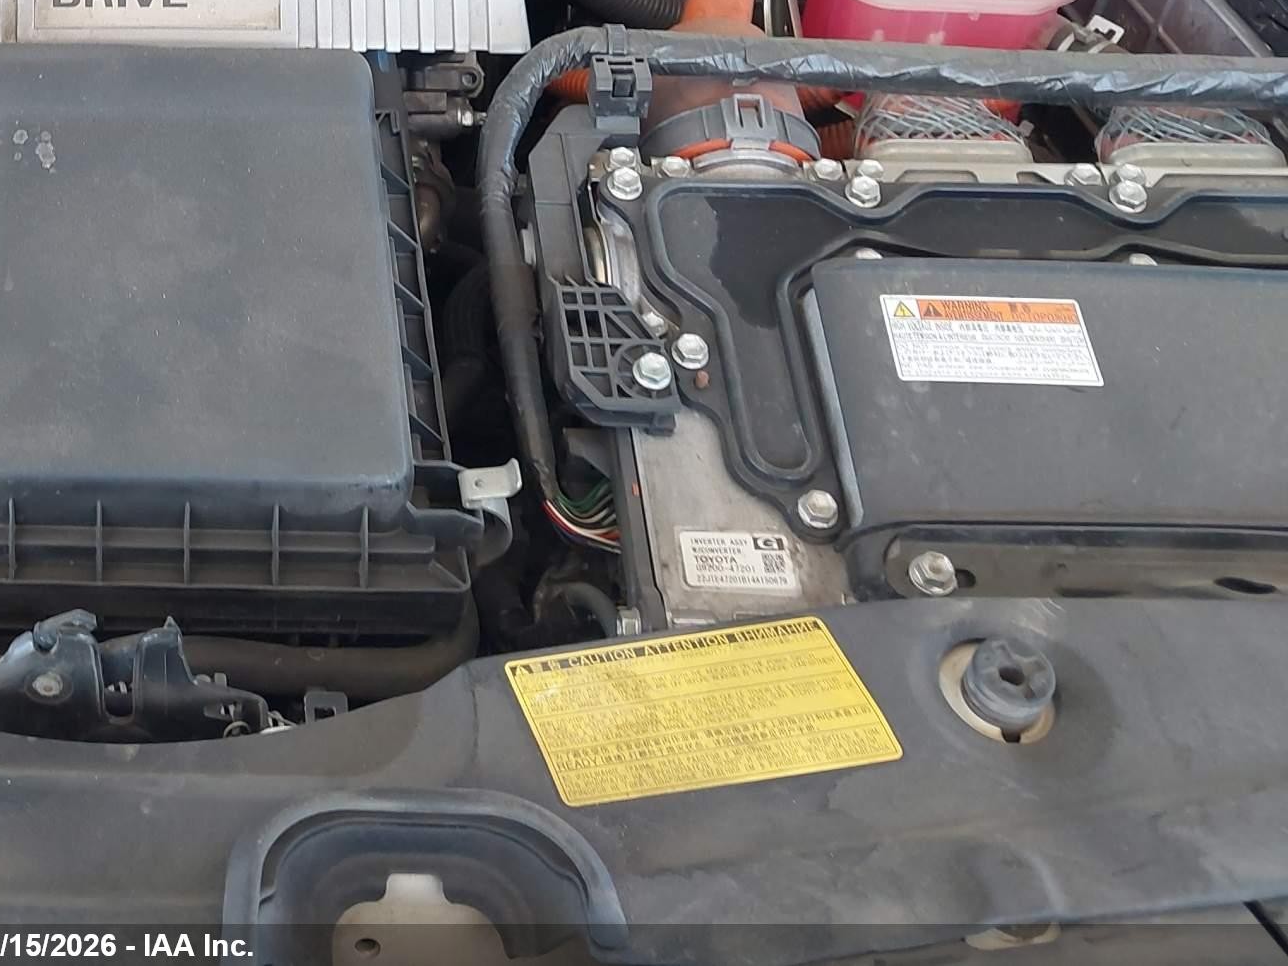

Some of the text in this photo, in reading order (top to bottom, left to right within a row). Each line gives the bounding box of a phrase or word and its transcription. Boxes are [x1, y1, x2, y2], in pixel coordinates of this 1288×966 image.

[942, 300, 990, 311] WARNING
[691, 538, 748, 546] INVERTER ASSY
[695, 555, 738, 565] TOYOTA
[567, 648, 636, 668] CAUTION
[644, 634, 728, 657] ATTENTION
